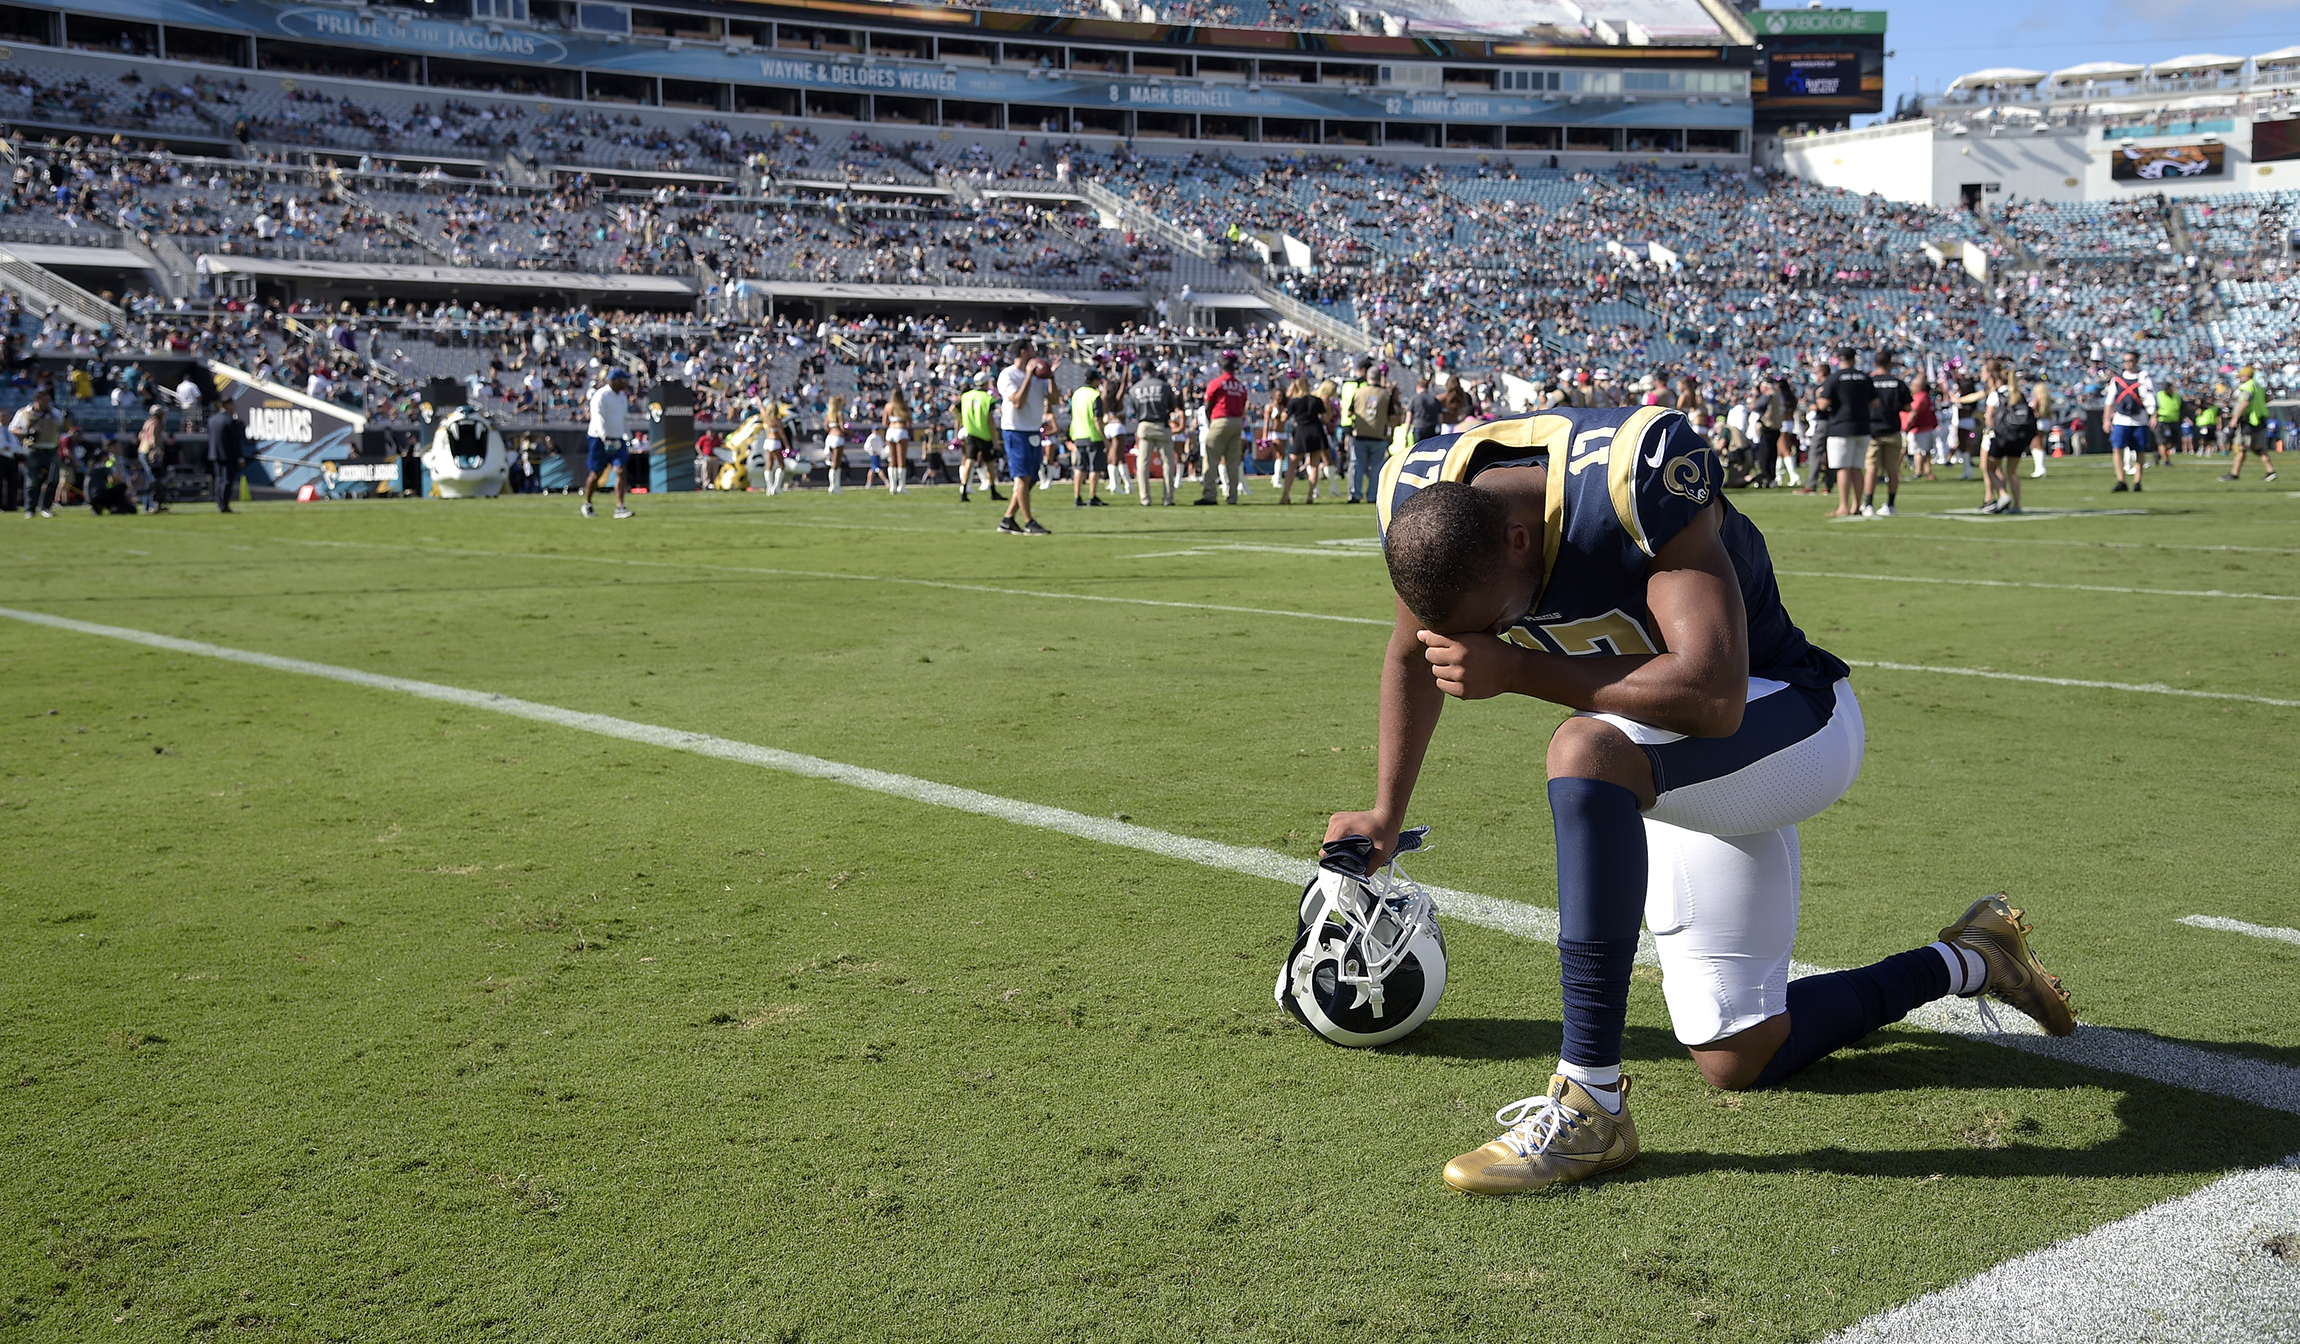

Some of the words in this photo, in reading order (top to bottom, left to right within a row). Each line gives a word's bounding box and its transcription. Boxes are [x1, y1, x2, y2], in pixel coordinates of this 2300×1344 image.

[316, 13, 381, 38] PRIDE
[447, 29, 536, 55] JAGUARS
[1788, 15, 1831, 30] XBOX
[1832, 14, 1866, 30] ONE
[760, 59, 814, 82] WAYNE
[816, 63, 828, 82] &
[831, 65, 896, 88] DELORES
[900, 71, 956, 92] WEAVER
[1109, 84, 1120, 103] 8
[1129, 86, 1169, 105] MARK
[1172, 88, 1232, 108] BRUNELL
[1385, 97, 1402, 115] 82
[1412, 99, 1449, 116] JIMMY
[1451, 101, 1489, 117] SMITH
[1134, 385, 1163, 400] SAFE
[1221, 380, 1244, 393] SAFE
[245, 406, 313, 443] JAGUARS
[1567, 427, 1617, 476] 17
[1398, 448, 1447, 489] 17
